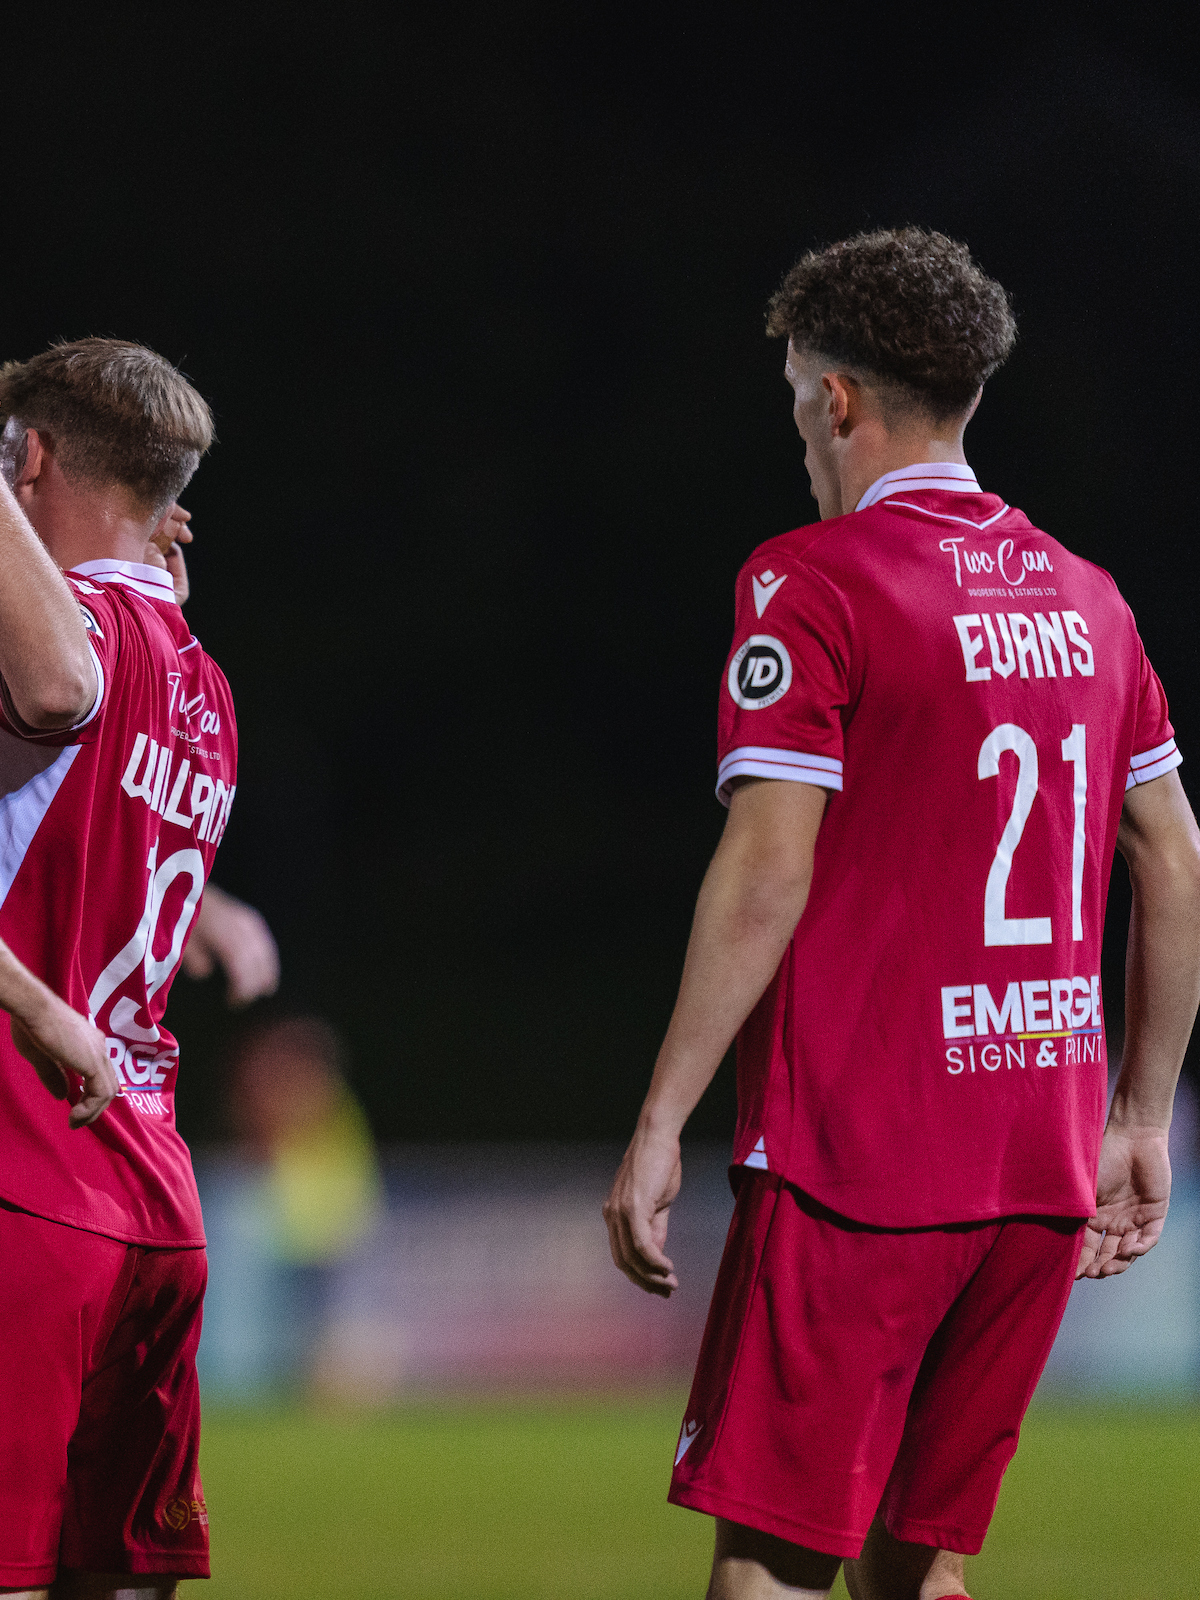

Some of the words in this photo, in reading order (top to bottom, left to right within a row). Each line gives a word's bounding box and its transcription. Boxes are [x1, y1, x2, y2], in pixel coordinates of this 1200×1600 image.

[939, 537, 995, 587] Two
[997, 538, 1053, 586] Can
[967, 588, 1007, 597] PROPERTIES
[1007, 588, 1016, 599] &
[1014, 587, 1043, 596] ESTATES
[1043, 587, 1057, 596] LTD
[953, 610, 1095, 682] EVANS
[977, 723, 1087, 947] 21
[941, 975, 1101, 1039] EMERGE
[105, 1036, 180, 1085] RGE
[944, 1041, 1026, 1075] SIGN
[1035, 1040, 1058, 1070] &
[1065, 1036, 1102, 1065] PRINT
